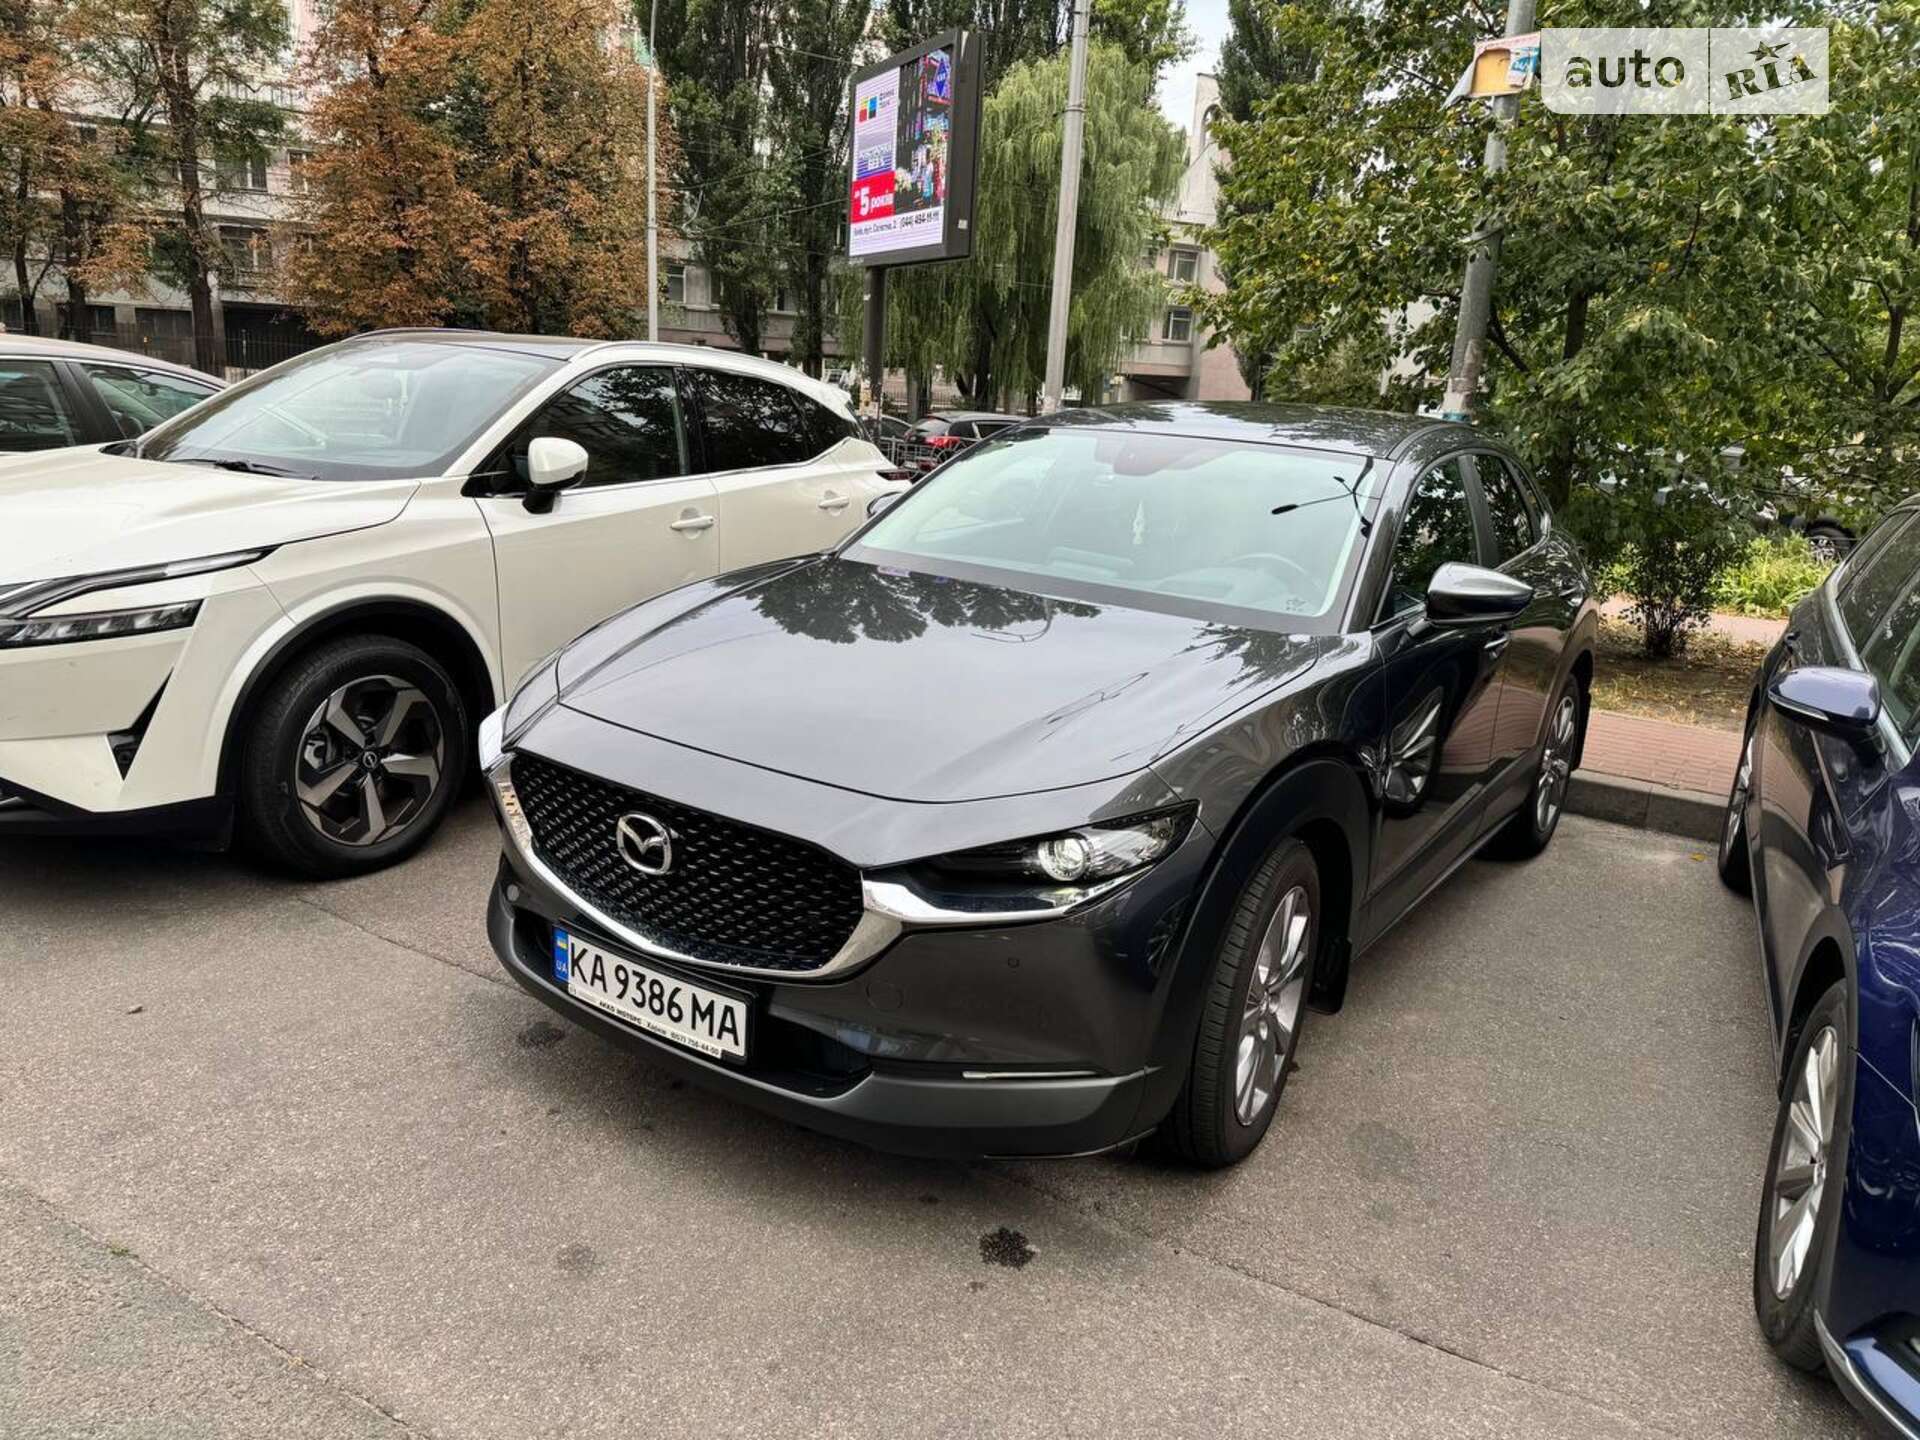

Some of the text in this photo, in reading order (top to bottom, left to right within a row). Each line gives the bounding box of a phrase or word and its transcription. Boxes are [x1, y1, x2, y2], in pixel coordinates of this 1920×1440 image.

[556, 961, 568, 974] UA
[571, 942, 740, 1047] KA 9386 MA
